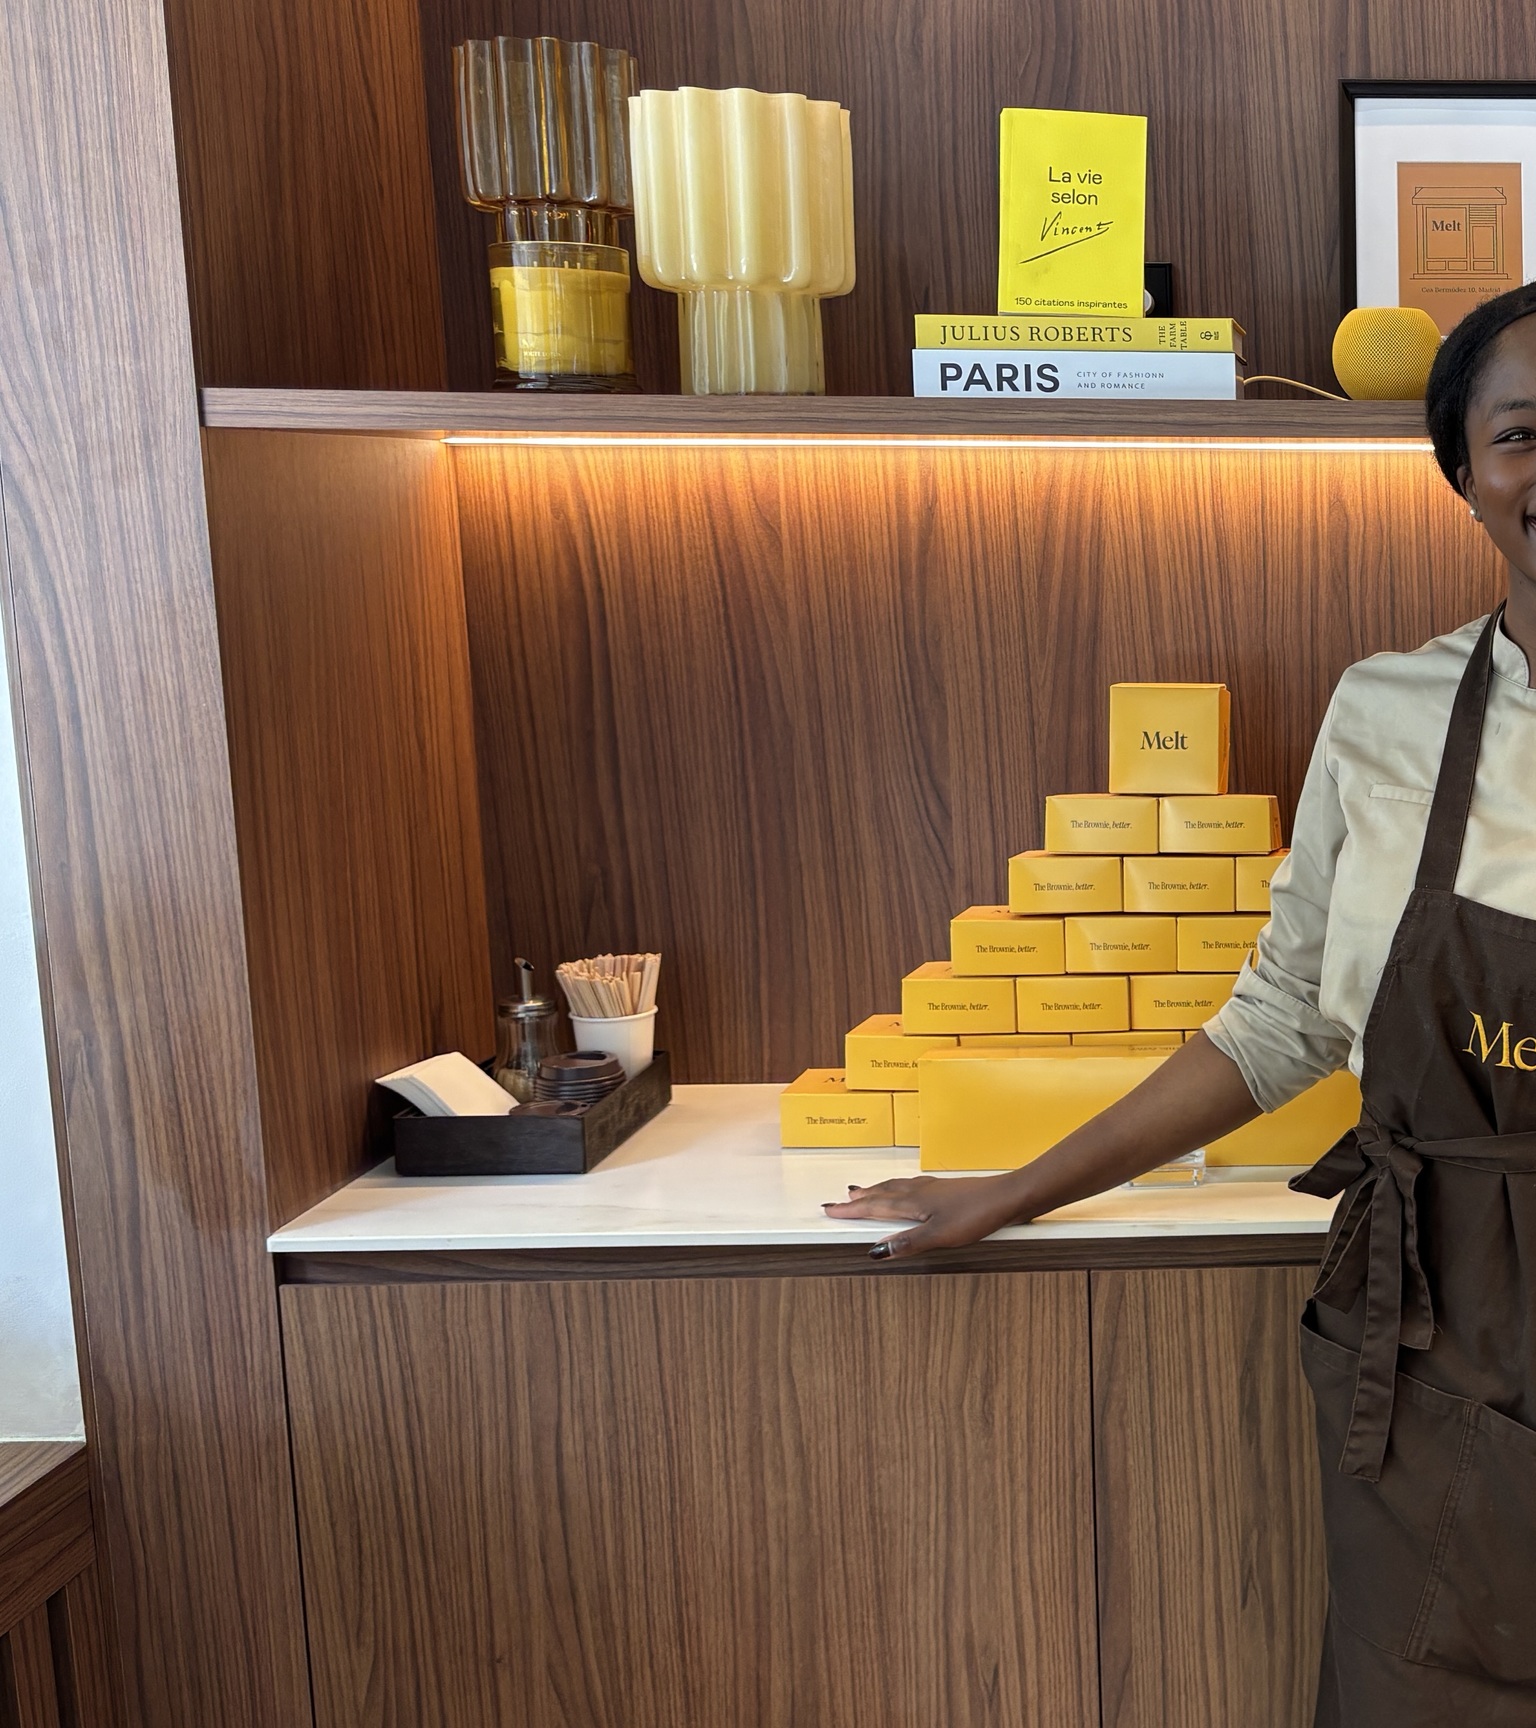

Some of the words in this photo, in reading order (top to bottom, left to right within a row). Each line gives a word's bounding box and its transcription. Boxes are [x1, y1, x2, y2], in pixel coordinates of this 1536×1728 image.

[1049, 166, 1072, 184] La
[1077, 169, 1103, 185] vie
[1051, 188, 1099, 206] selon
[1036, 211, 1114, 246] Vincent
[1431, 220, 1462, 232] Melt
[1014, 297, 1033, 307] 150
[1034, 297, 1075, 308] citations
[1077, 298, 1128, 311] inspirantes
[940, 325, 1021, 345] JULIUS
[1028, 326, 1133, 343] ROBERTS
[1158, 325, 1166, 345] THE
[1169, 322, 1177, 348] FARM
[1180, 320, 1188, 350] TABLE
[939, 363, 1061, 393] PARIS
[1100, 382, 1146, 390] ROMANCE
[1139, 731, 1189, 751] Melt
[1071, 819, 1083, 829] The
[1084, 819, 1111, 830] Brownie,
[1112, 820, 1132, 829] better.
[1184, 820, 1196, 830] The
[1198, 820, 1224, 830] Brownie,
[1225, 820, 1245, 829] better.
[1033, 882, 1046, 892] The
[1047, 882, 1074, 892] Brownie,
[1075, 882, 1095, 891] better.
[1148, 881, 1160, 891] The
[1161, 881, 1188, 891] Brownie,
[1189, 881, 1209, 891] better.
[1260, 879, 1270, 889] Th
[976, 944, 988, 954] The
[989, 944, 1016, 954] Brownie,
[1018, 944, 1038, 954] better.
[1090, 942, 1102, 951] The
[1103, 942, 1130, 952] Brownie,
[1131, 941, 1151, 951] better.
[1202, 940, 1214, 950] The
[1215, 940, 1242, 950] Brownie,
[927, 1002, 940, 1011] The
[941, 1002, 968, 1012] Brownie,
[969, 1002, 989, 1011] better.
[1041, 1002, 1053, 1011] The
[1054, 1002, 1081, 1011] Brownie,
[1082, 1001, 1102, 1011] better.
[1153, 999, 1166, 1009] The
[1167, 999, 1194, 1009] Brownie,
[1195, 999, 1215, 1009] better.
[870, 1059, 883, 1068] The
[883, 1059, 911, 1069] Brownie,
[806, 1116, 818, 1125] The
[819, 1115, 847, 1126] Brownie,
[848, 1116, 868, 1125] better.
